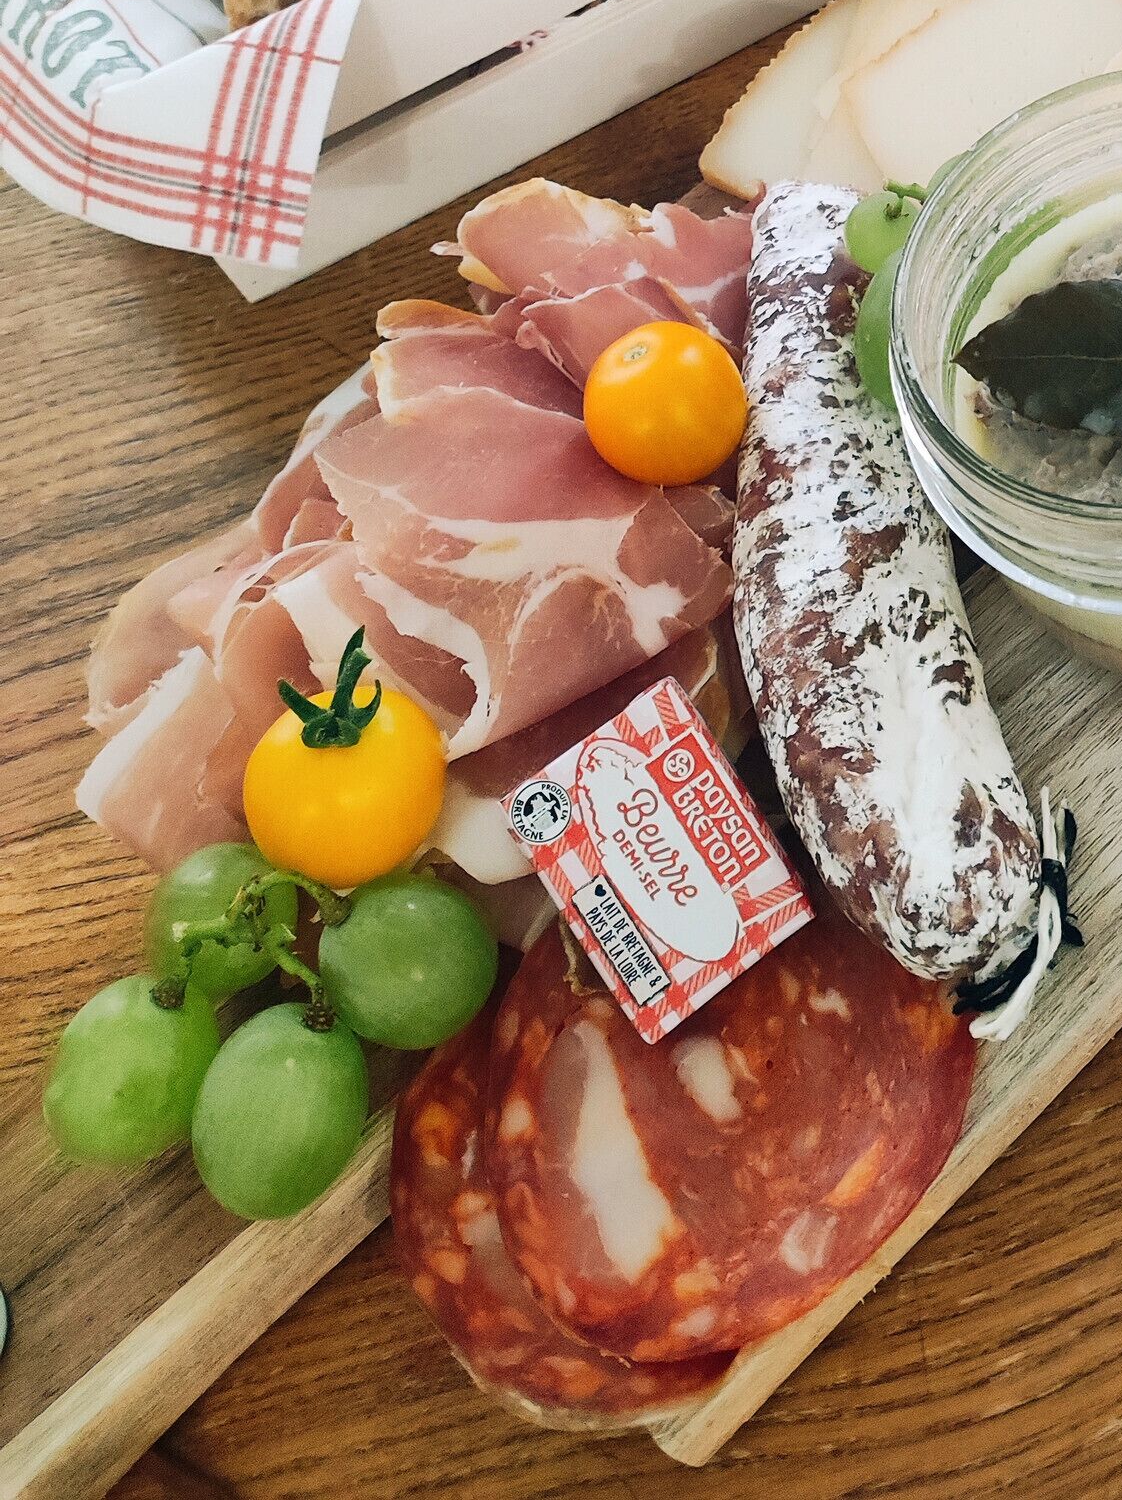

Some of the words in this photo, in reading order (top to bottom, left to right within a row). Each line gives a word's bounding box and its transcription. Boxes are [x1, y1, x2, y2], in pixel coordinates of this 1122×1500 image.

[513, 799, 544, 840] BRETAGNE
[541, 784, 568, 806] PRODUIT
[560, 810, 568, 820] EN
[612, 828, 661, 901] DEMI-SEL
[616, 788, 698, 906] Beurre
[585, 906, 608, 933] PAYS
[600, 929, 616, 946] DE
[609, 943, 625, 960] LA
[618, 957, 642, 987] LOIRE
[599, 896, 622, 921] LAIT
[613, 917, 629, 934] DE
[621, 931, 657, 978] BRETAGNE
[649, 975, 662, 988] &
